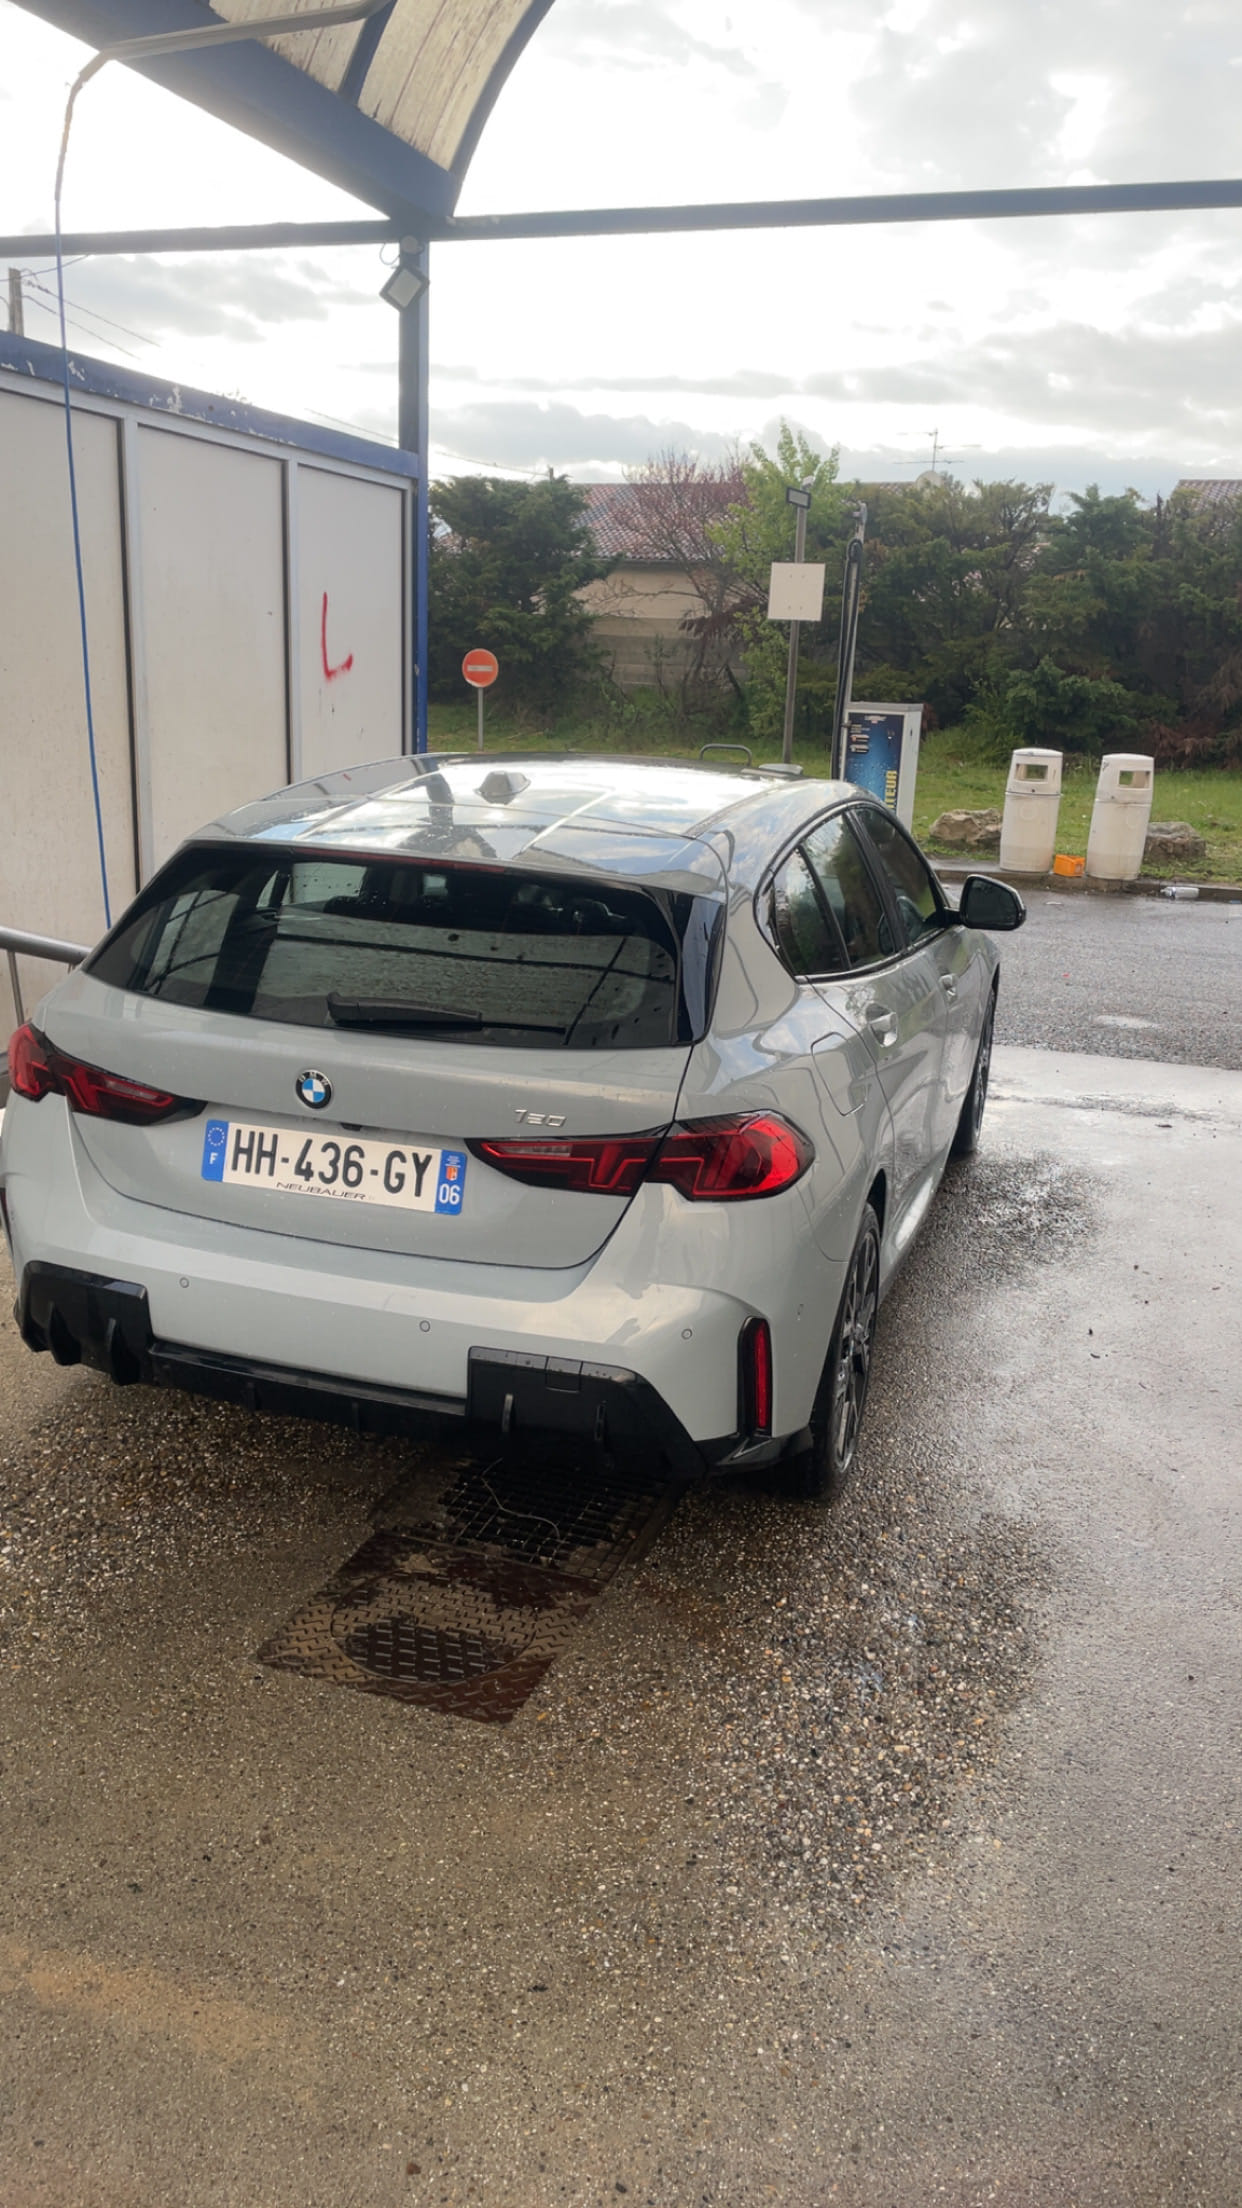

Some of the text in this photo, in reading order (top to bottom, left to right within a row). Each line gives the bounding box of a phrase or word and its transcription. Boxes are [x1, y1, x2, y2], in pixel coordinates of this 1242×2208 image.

[514, 1109, 567, 1127] 120
[209, 1152, 219, 1165] F
[231, 1129, 433, 1197] HH-436-GY
[276, 1182, 366, 1200] NEUBAUER
[439, 1183, 461, 1205] 06
